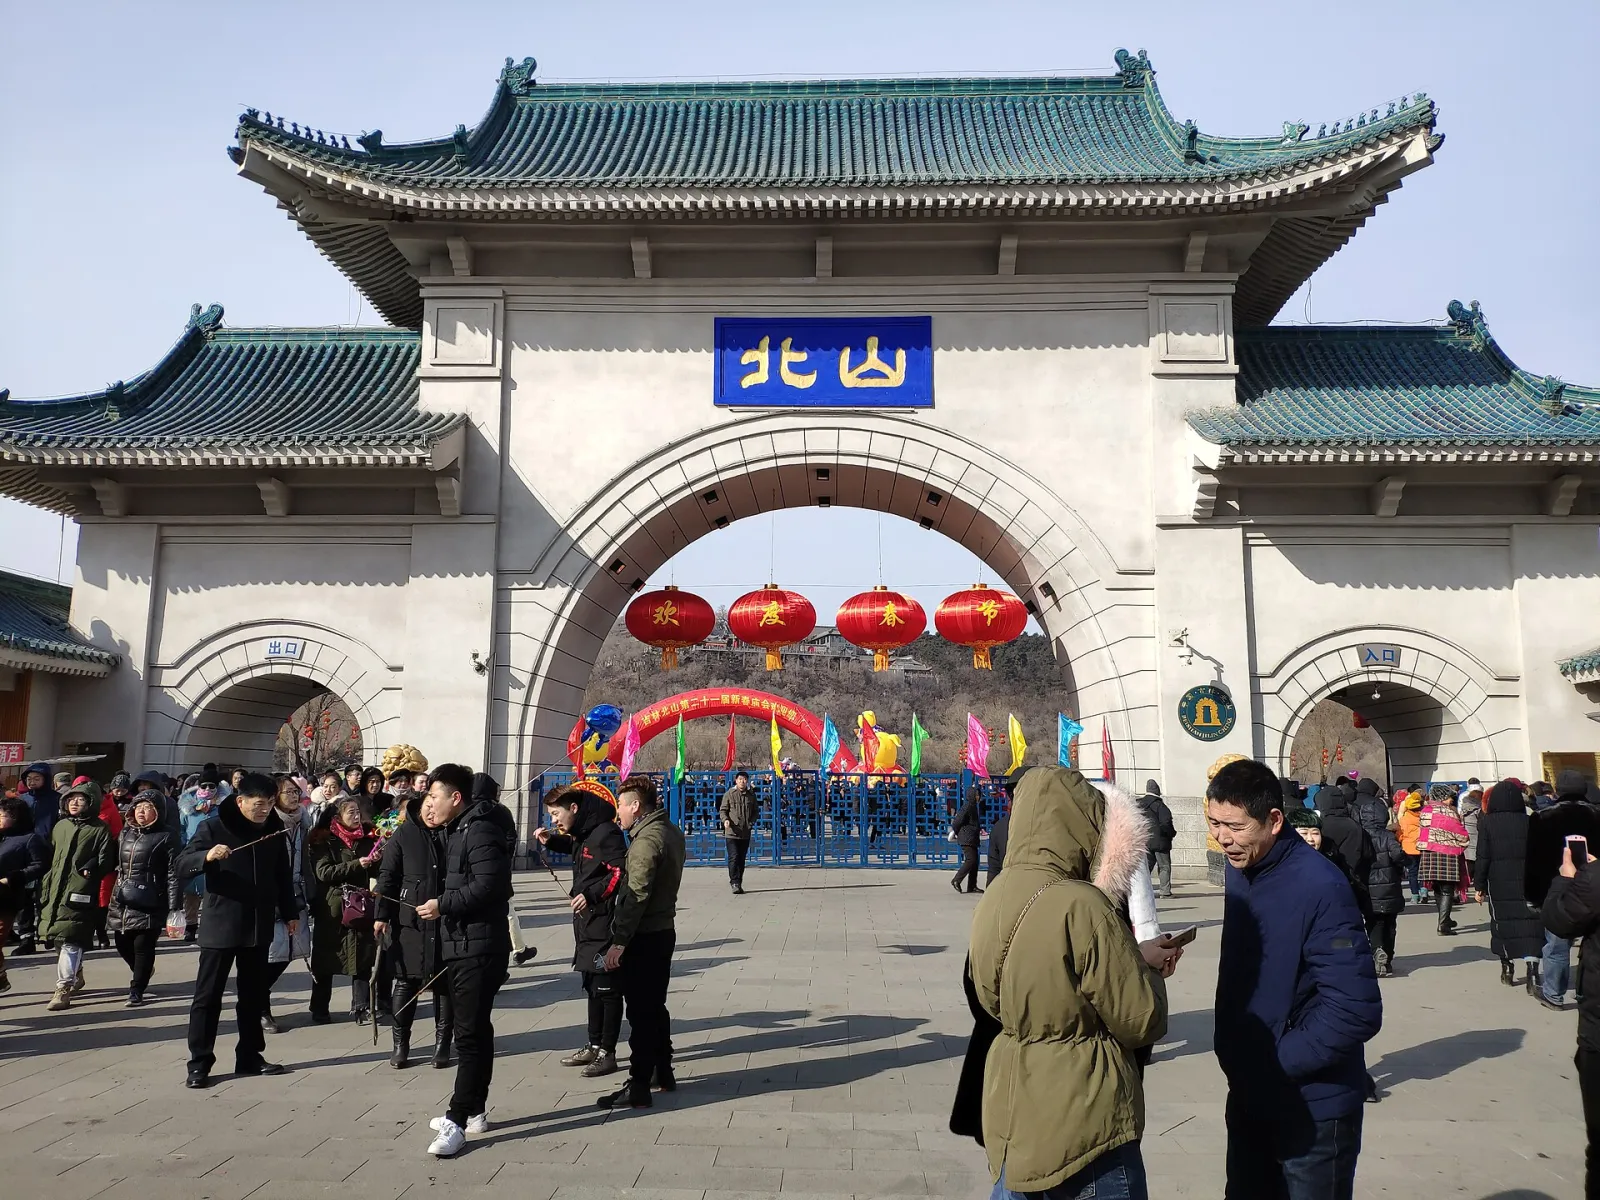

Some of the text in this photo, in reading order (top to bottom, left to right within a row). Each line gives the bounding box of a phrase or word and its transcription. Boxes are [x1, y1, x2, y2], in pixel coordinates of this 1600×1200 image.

[740, 335, 906, 389] 北山
[652, 600, 680, 626] 欢
[759, 600, 786, 627] 度
[878, 600, 905, 627] 春
[976, 599, 999, 627] 节
[268, 640, 298, 655] 出口
[1365, 648, 1394, 662] 入口
